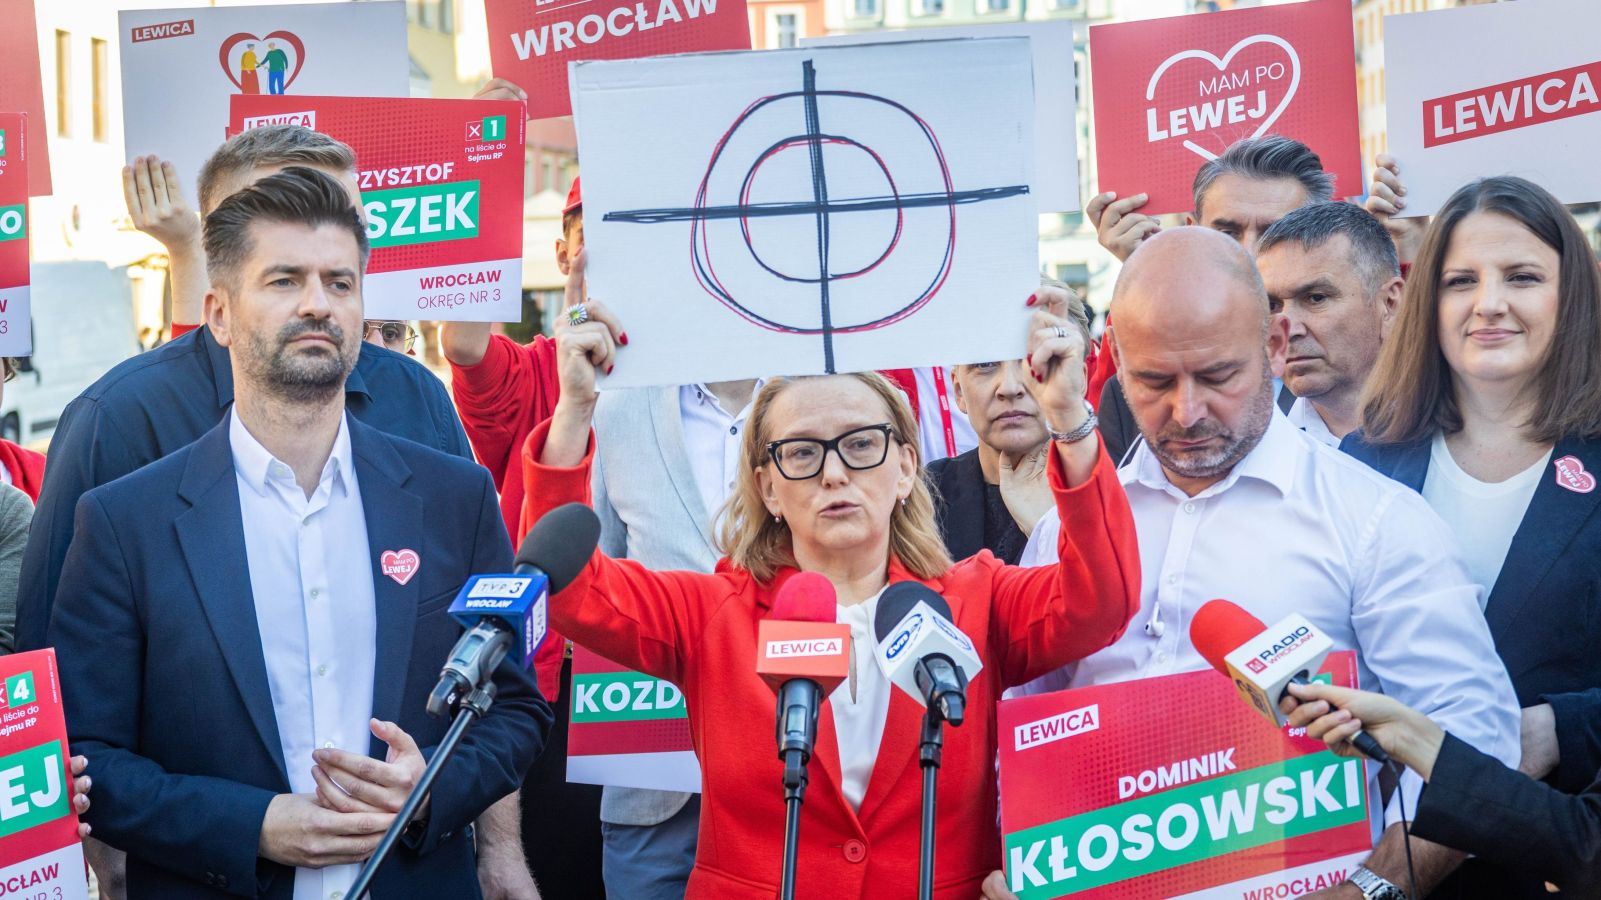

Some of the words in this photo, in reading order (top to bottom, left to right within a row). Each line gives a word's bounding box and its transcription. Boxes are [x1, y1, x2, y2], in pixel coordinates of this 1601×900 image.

[134, 22, 192, 42] LEWICA
[511, 0, 717, 61] WROCŁAW
[1199, 69, 1250, 97] MAM
[1255, 62, 1285, 84] PO
[1146, 90, 1268, 143] LEWEJ
[1433, 71, 1599, 139] LEWICA
[490, 119, 498, 137] 1
[467, 153, 492, 163] Sejmu
[493, 151, 503, 160] RP
[496, 142, 507, 150] do
[363, 190, 477, 239] SZEK
[419, 269, 502, 291] WROCŁAW
[417, 292, 466, 310] OKRĘG
[469, 290, 488, 304] NR
[492, 288, 502, 302] 3
[1556, 459, 1581, 487] LEWEJ
[383, 564, 412, 574] LEWEJ
[509, 581, 524, 594] 3
[771, 641, 838, 655] LEWICA
[1259, 626, 1310, 661] RADIO
[13, 678, 30, 701] 4
[575, 680, 687, 714] KOZD
[3, 709, 26, 724] liście
[27, 705, 39, 715] do
[25, 717, 37, 728] RP
[1019, 709, 1095, 746] LEWICA
[1118, 747, 1237, 800] DOMINIK
[0, 753, 62, 822] EJ
[1010, 759, 1362, 893] KŁOSOWSKI
[53, 886, 63, 900] 3
[1243, 868, 1348, 900] WROCŁAW
